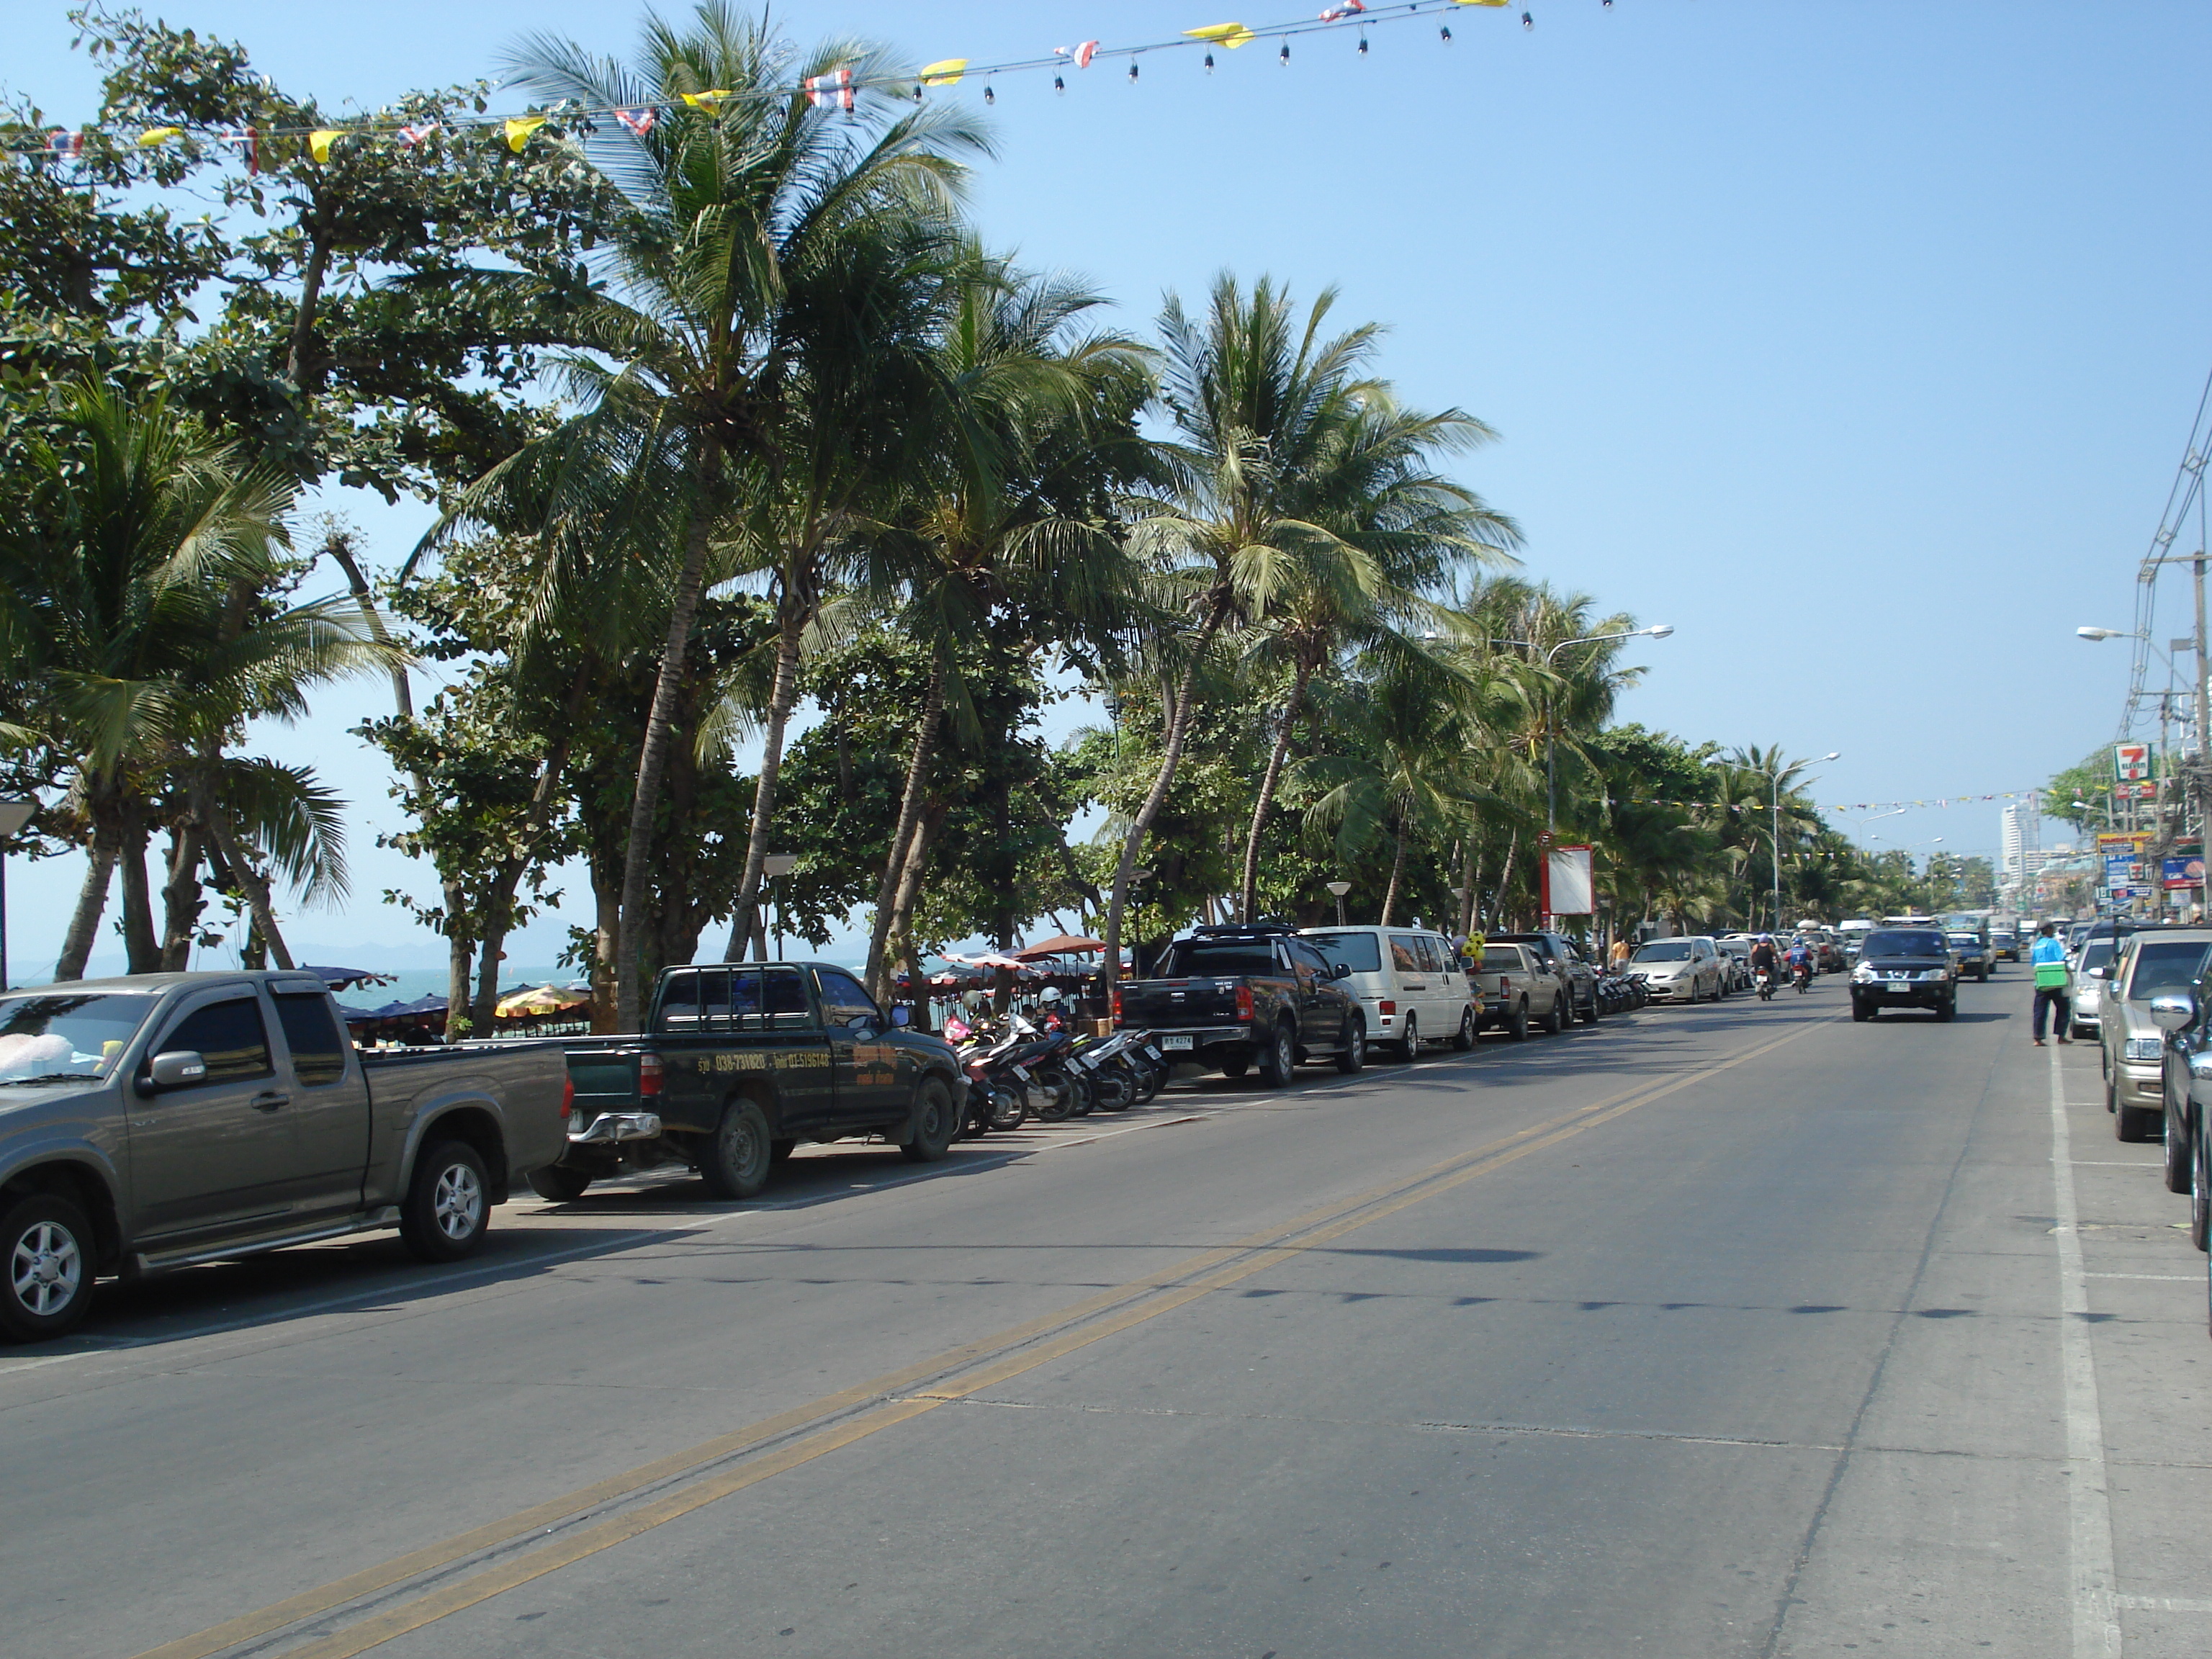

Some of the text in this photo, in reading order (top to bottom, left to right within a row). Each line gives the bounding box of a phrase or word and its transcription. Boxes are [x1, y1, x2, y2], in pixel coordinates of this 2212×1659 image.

[2121, 748, 2144, 779] 7
[2129, 787, 2142, 797] 24
[788, 1053, 830, 1069] 01-5196148
